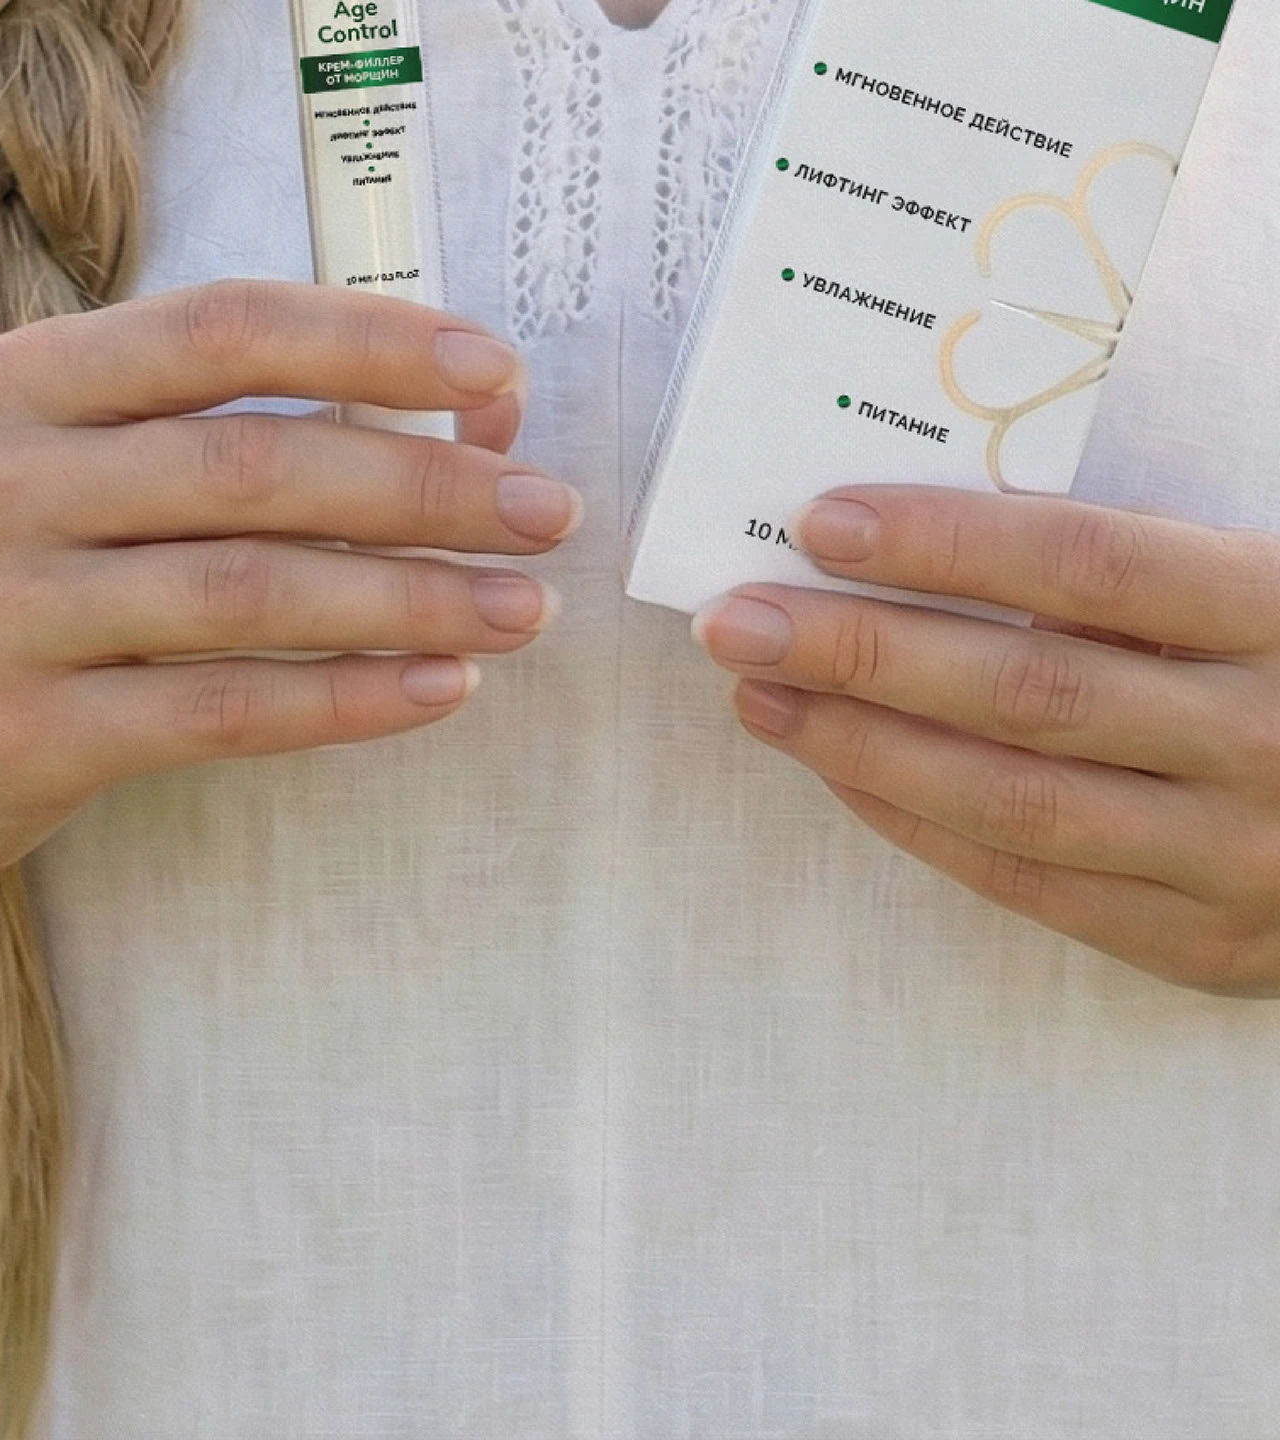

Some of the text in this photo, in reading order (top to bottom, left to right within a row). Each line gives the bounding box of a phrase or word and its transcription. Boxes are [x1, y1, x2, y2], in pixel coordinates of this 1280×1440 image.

[333, 0, 378, 23] Age
[317, 19, 398, 44] Control
[318, 55, 405, 73] КРЕМ-ФИЛЛЕР
[325, 68, 400, 86] ОТ МОРЩИН
[834, 66, 1074, 159] МГНОВЕННОЕ ДЕЙСТВИЕ
[793, 162, 973, 234] ЛИФТИНГ ЭФФЕКТ
[802, 271, 937, 330] УВЛАЖНЕНИЕ
[857, 399, 950, 444] ПИТАНИЕ
[744, 517, 773, 541] 10
